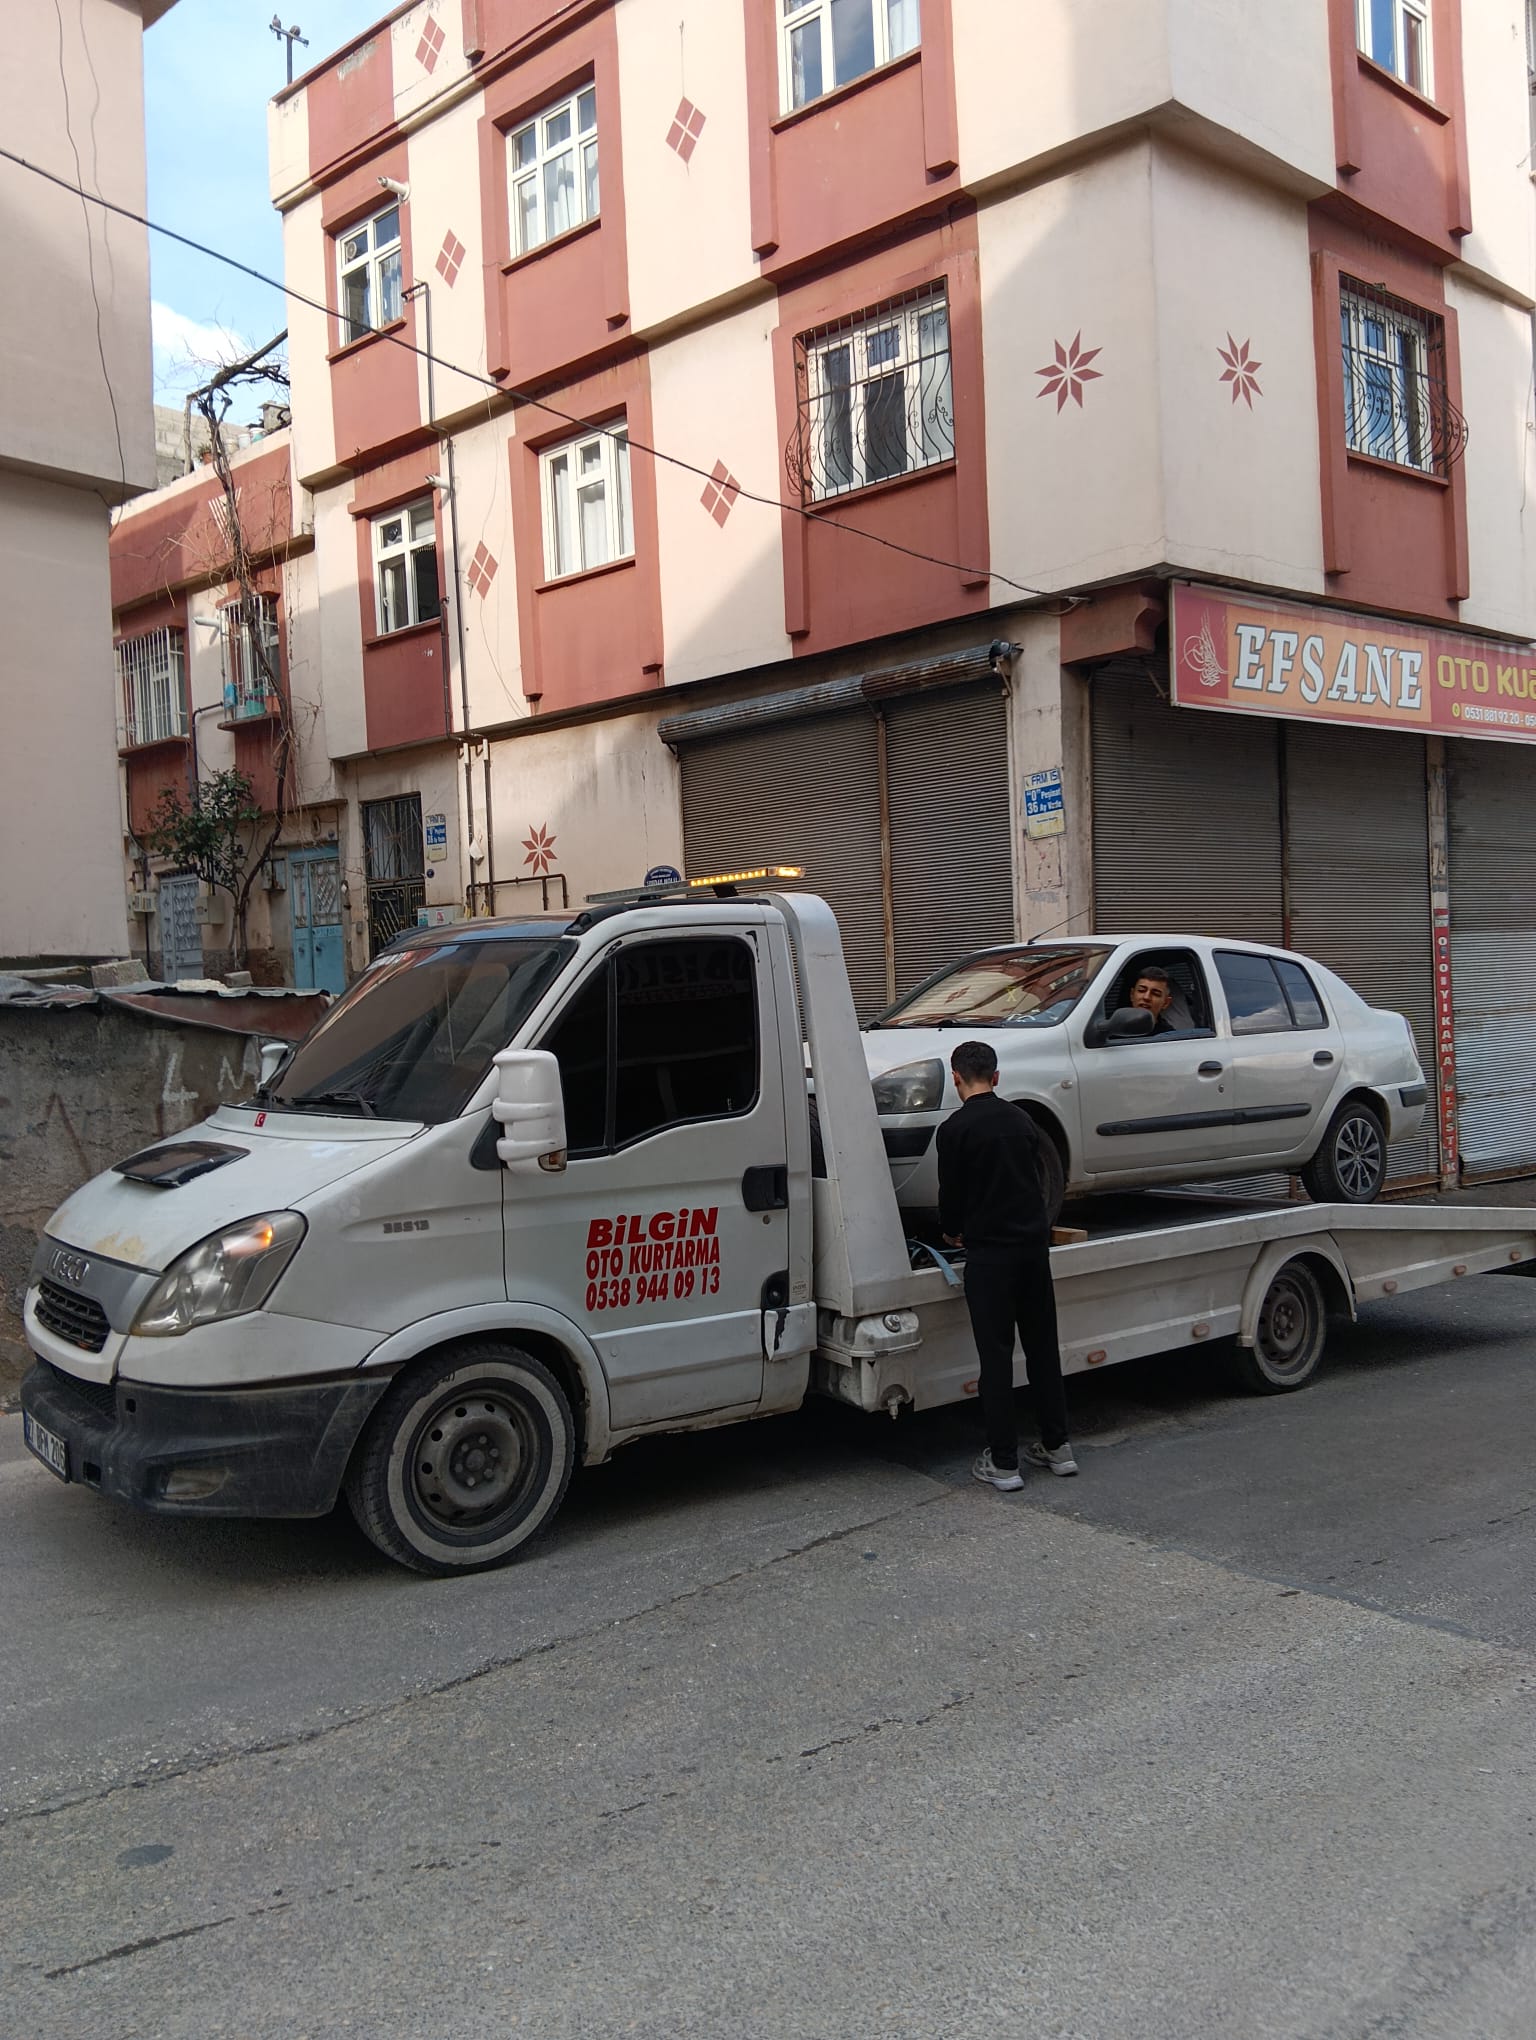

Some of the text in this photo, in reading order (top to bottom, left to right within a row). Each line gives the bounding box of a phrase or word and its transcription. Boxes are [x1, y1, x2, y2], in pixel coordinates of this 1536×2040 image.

[1233, 623, 1423, 709] EFSANE
[1437, 655, 1489, 693] OTO
[1027, 801, 1039, 814] 36
[586, 1236, 720, 1280] OTO KURTARMA
[586, 1266, 720, 1311] 0538 944 09 13
